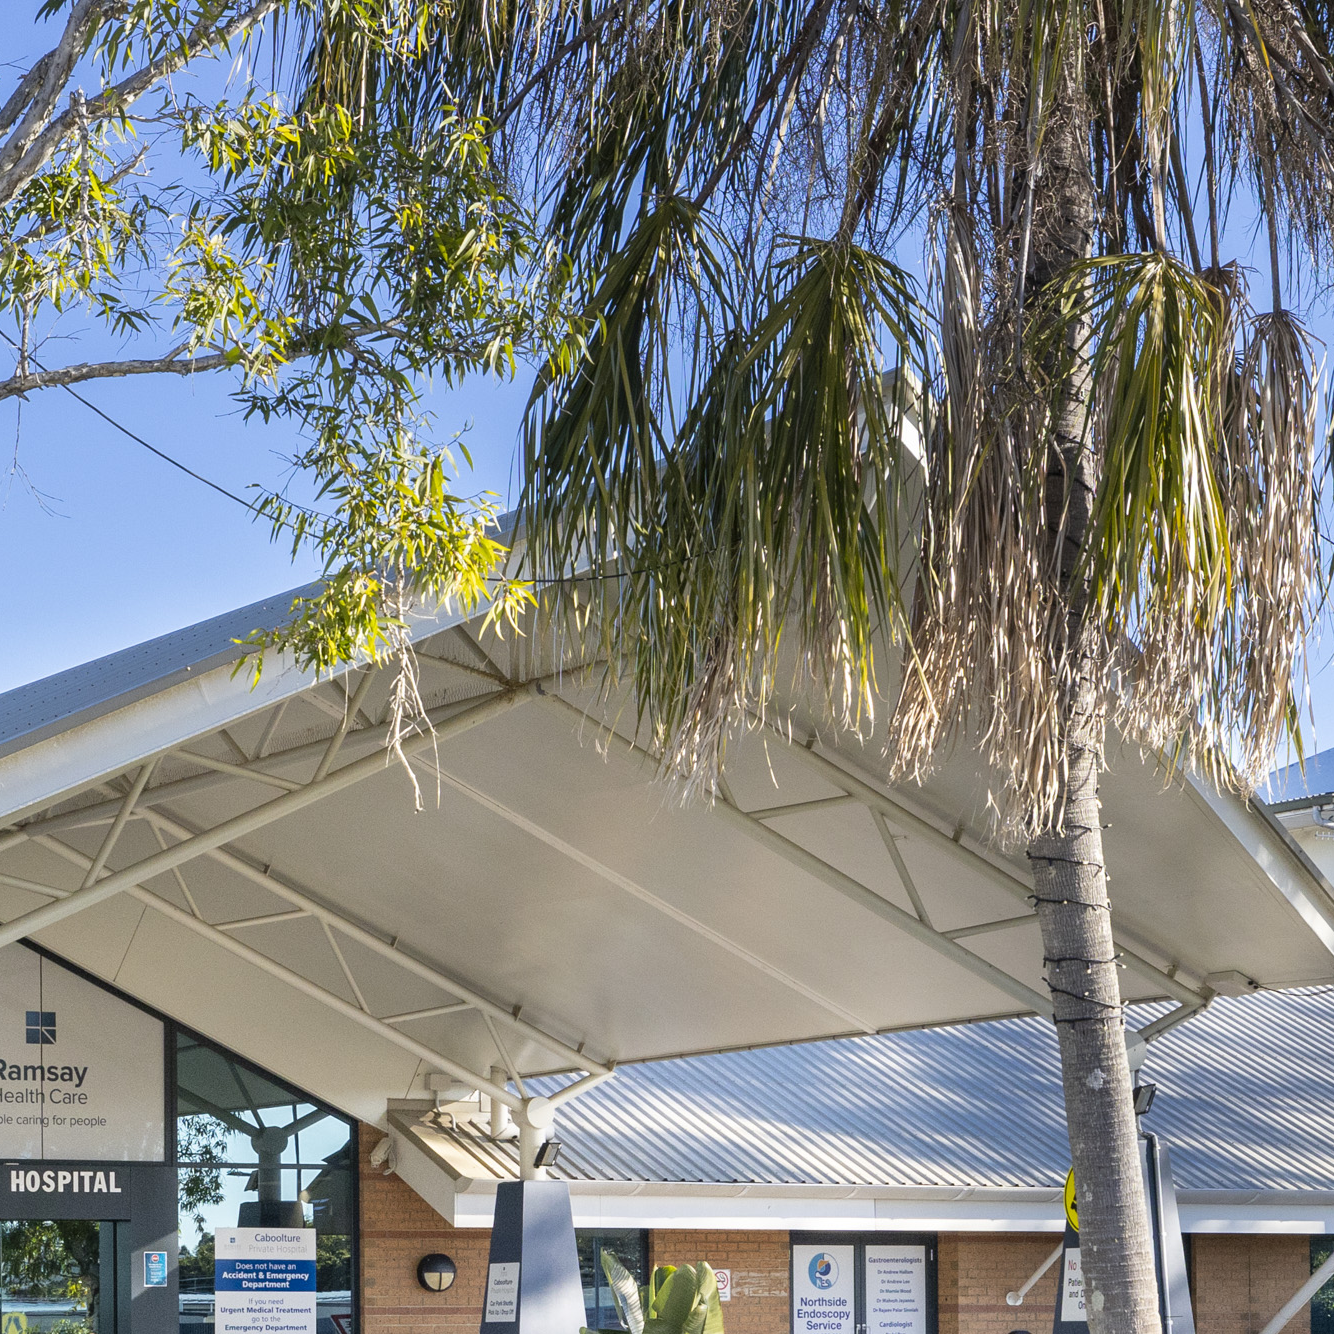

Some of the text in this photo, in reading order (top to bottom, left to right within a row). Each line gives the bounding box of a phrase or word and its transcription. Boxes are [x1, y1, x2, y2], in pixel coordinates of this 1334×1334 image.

[50, 1089, 88, 1105] Care
[16, 1115, 50, 1127] caring
[52, 1114, 67, 1125] for
[69, 1115, 107, 1127] people
[10, 1170, 122, 1193] HOSPITAL
[255, 1233, 301, 1243] Caboolture
[249, 1245, 274, 1254] Private
[276, 1245, 308, 1254] Hospital
[235, 1262, 253, 1270] Does
[269, 1262, 286, 1270] have
[1068, 1260, 1077, 1270] No
[266, 1272, 309, 1281] Emergency
[242, 1281, 290, 1289] Department
[800, 1297, 847, 1307] Northside
[220, 1307, 245, 1315] Urgent
[797, 1309, 850, 1320] Endoscopy
[224, 1324, 307, 1332] Emergency Department
[806, 1321, 842, 1330] Service
